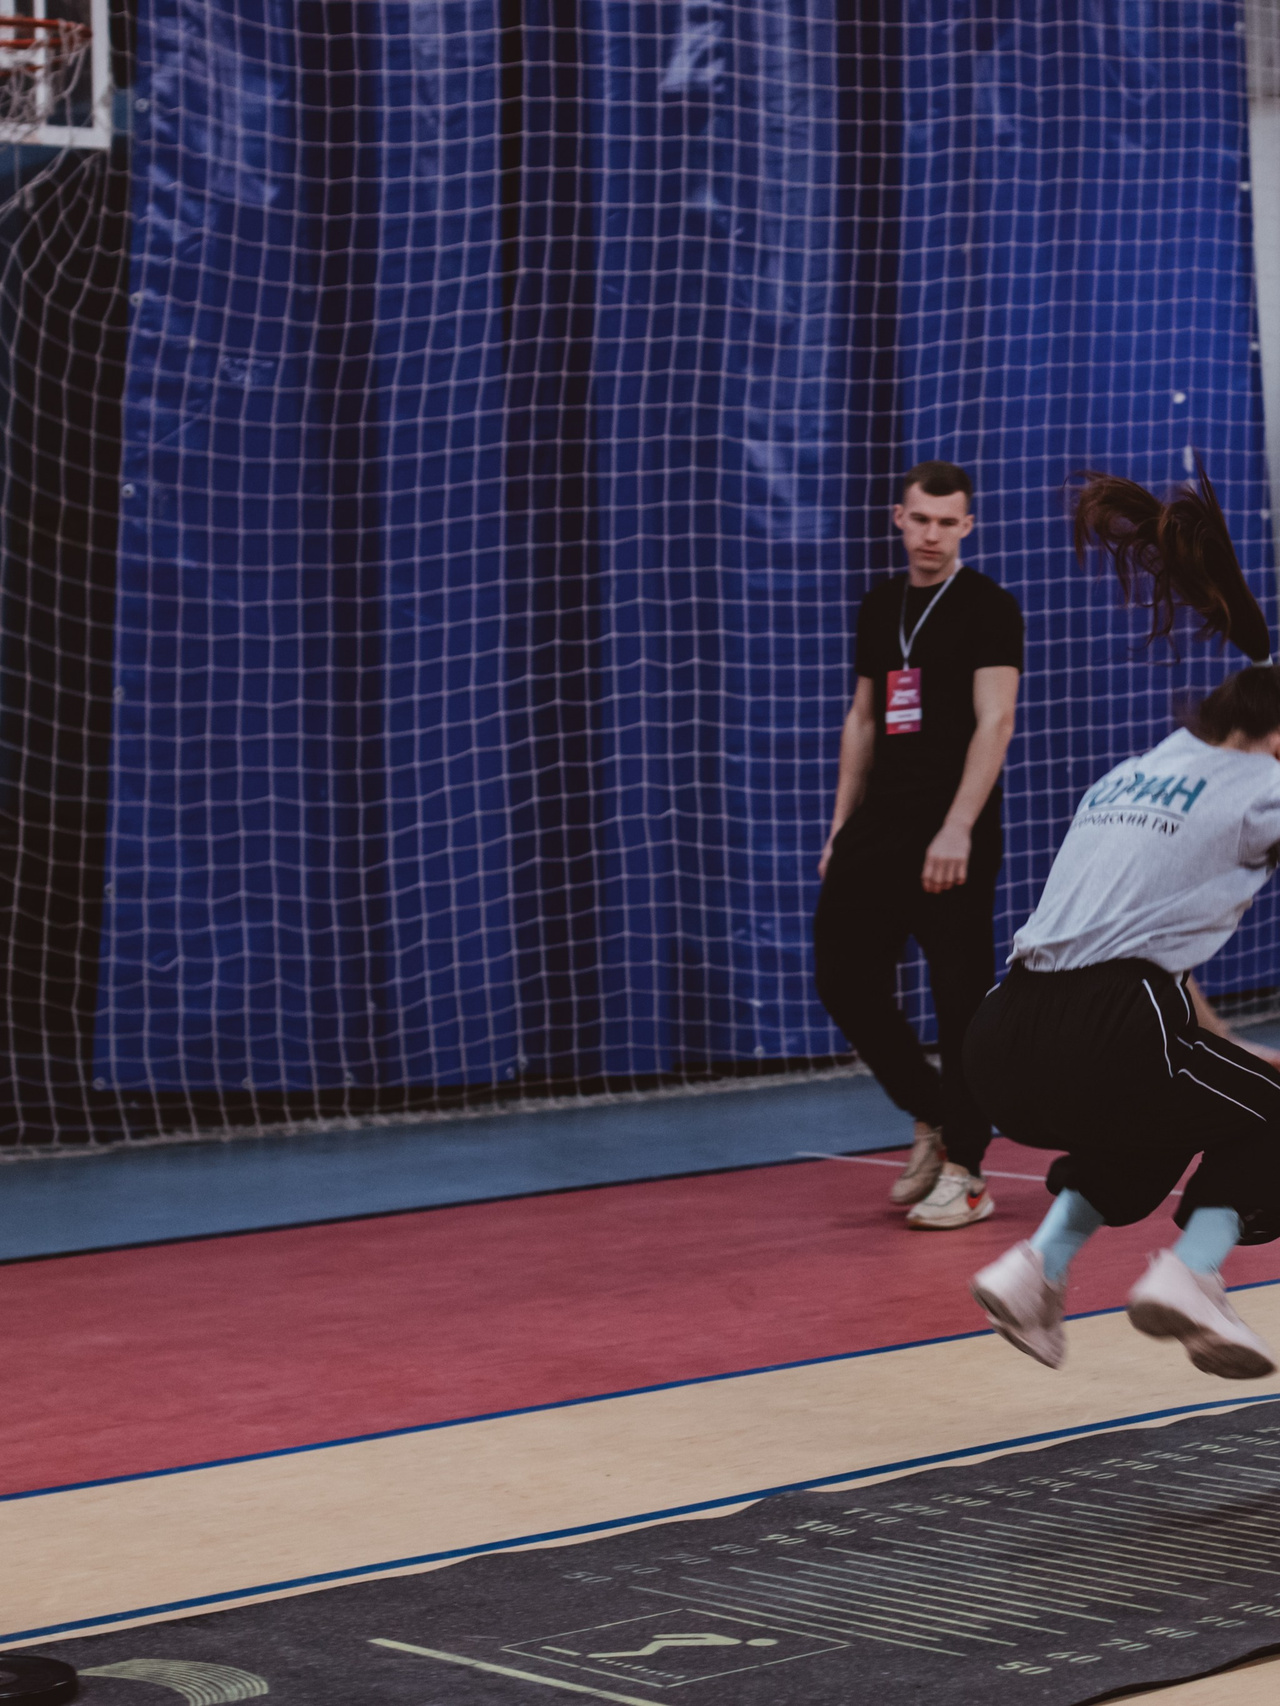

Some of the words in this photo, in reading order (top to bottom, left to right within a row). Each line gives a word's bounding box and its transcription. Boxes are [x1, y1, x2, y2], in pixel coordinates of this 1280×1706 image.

[1194, 1615, 1246, 1628] 90
[1146, 1627, 1198, 1639] 80
[1099, 1638, 1152, 1651] 70
[1046, 1651, 1102, 1663] 60
[996, 1661, 1052, 1675] 50
